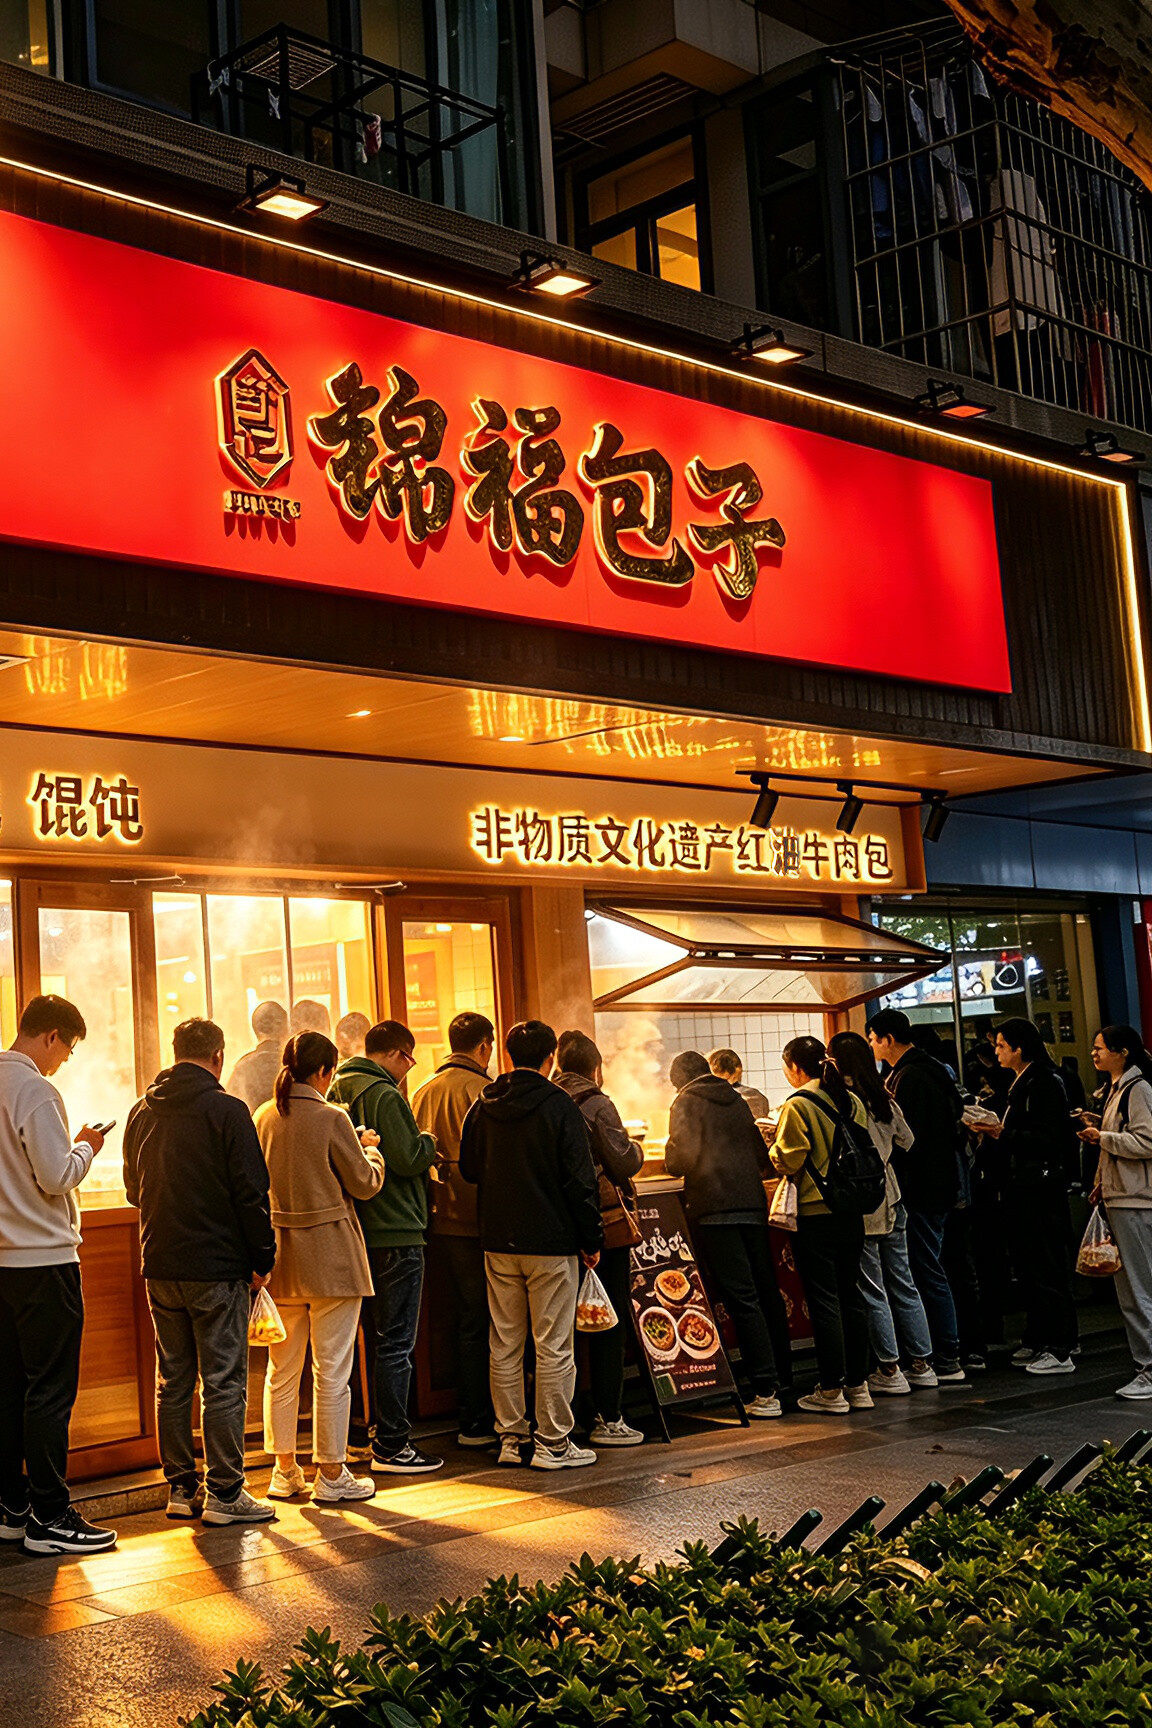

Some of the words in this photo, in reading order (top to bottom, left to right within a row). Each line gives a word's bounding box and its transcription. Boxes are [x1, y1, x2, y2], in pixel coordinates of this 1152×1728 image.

[308, 361, 786, 601] 锦福包子
[32, 773, 144, 841] 馄饨
